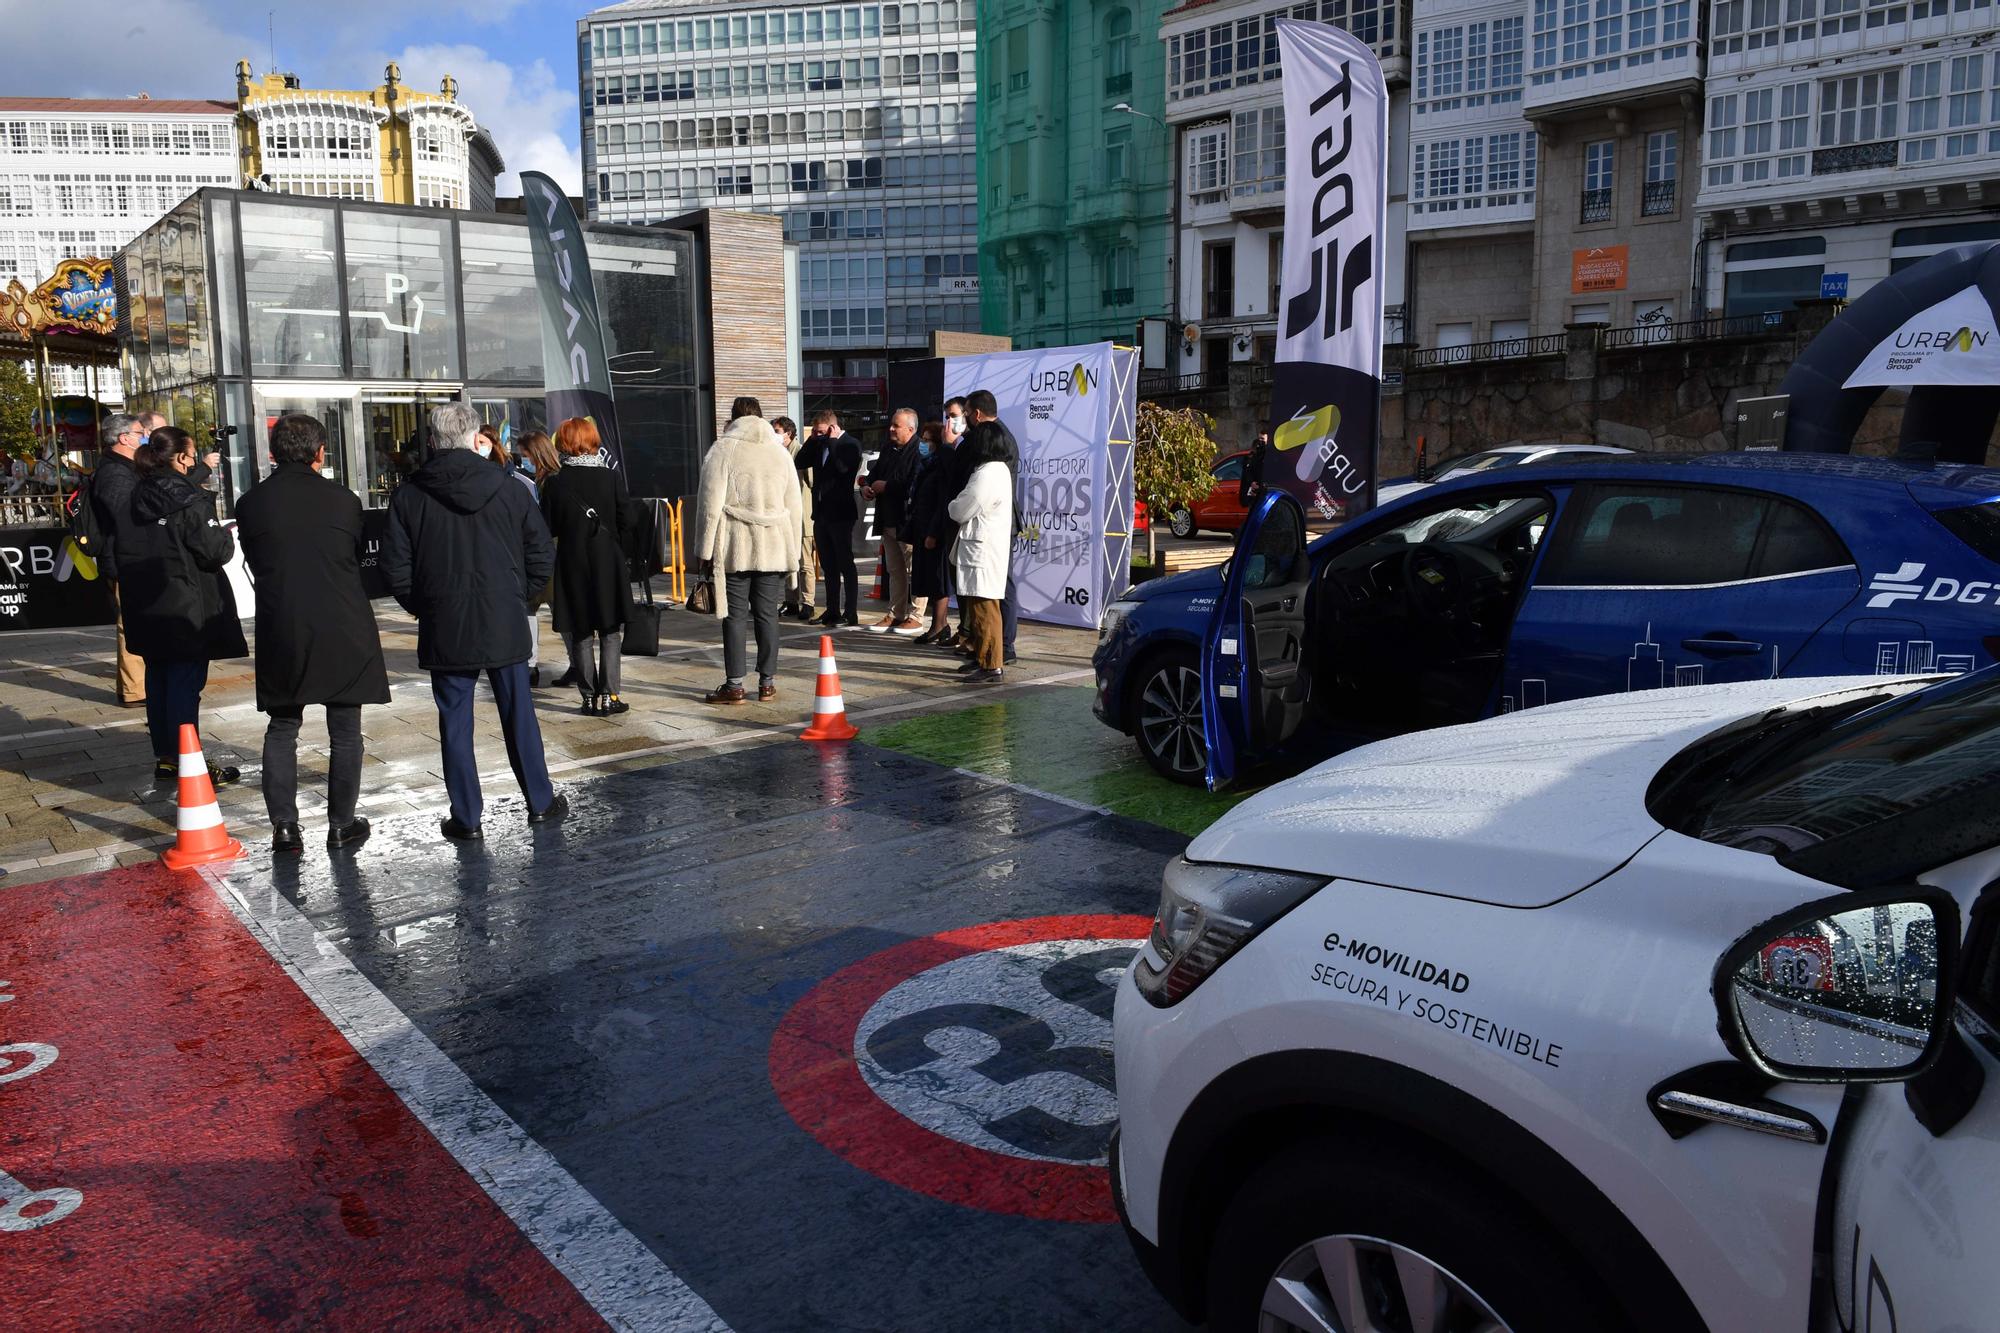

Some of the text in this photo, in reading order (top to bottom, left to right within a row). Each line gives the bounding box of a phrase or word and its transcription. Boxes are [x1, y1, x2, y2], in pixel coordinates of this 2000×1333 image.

[1823, 282, 1847, 290] TAXI
[1030, 363, 1098, 396] URBAN
[1029, 412, 1049, 420] Group
[1030, 404, 1054, 412] Renault
[1048, 459, 1089, 474] ETORRI
[1065, 586, 1089, 606] RG
[1923, 577, 2000, 605] DG
[1324, 932, 1470, 993] e-MOVILIDAD
[1311, 963, 1563, 1068] SEGURA Y SOSTENIBLE
